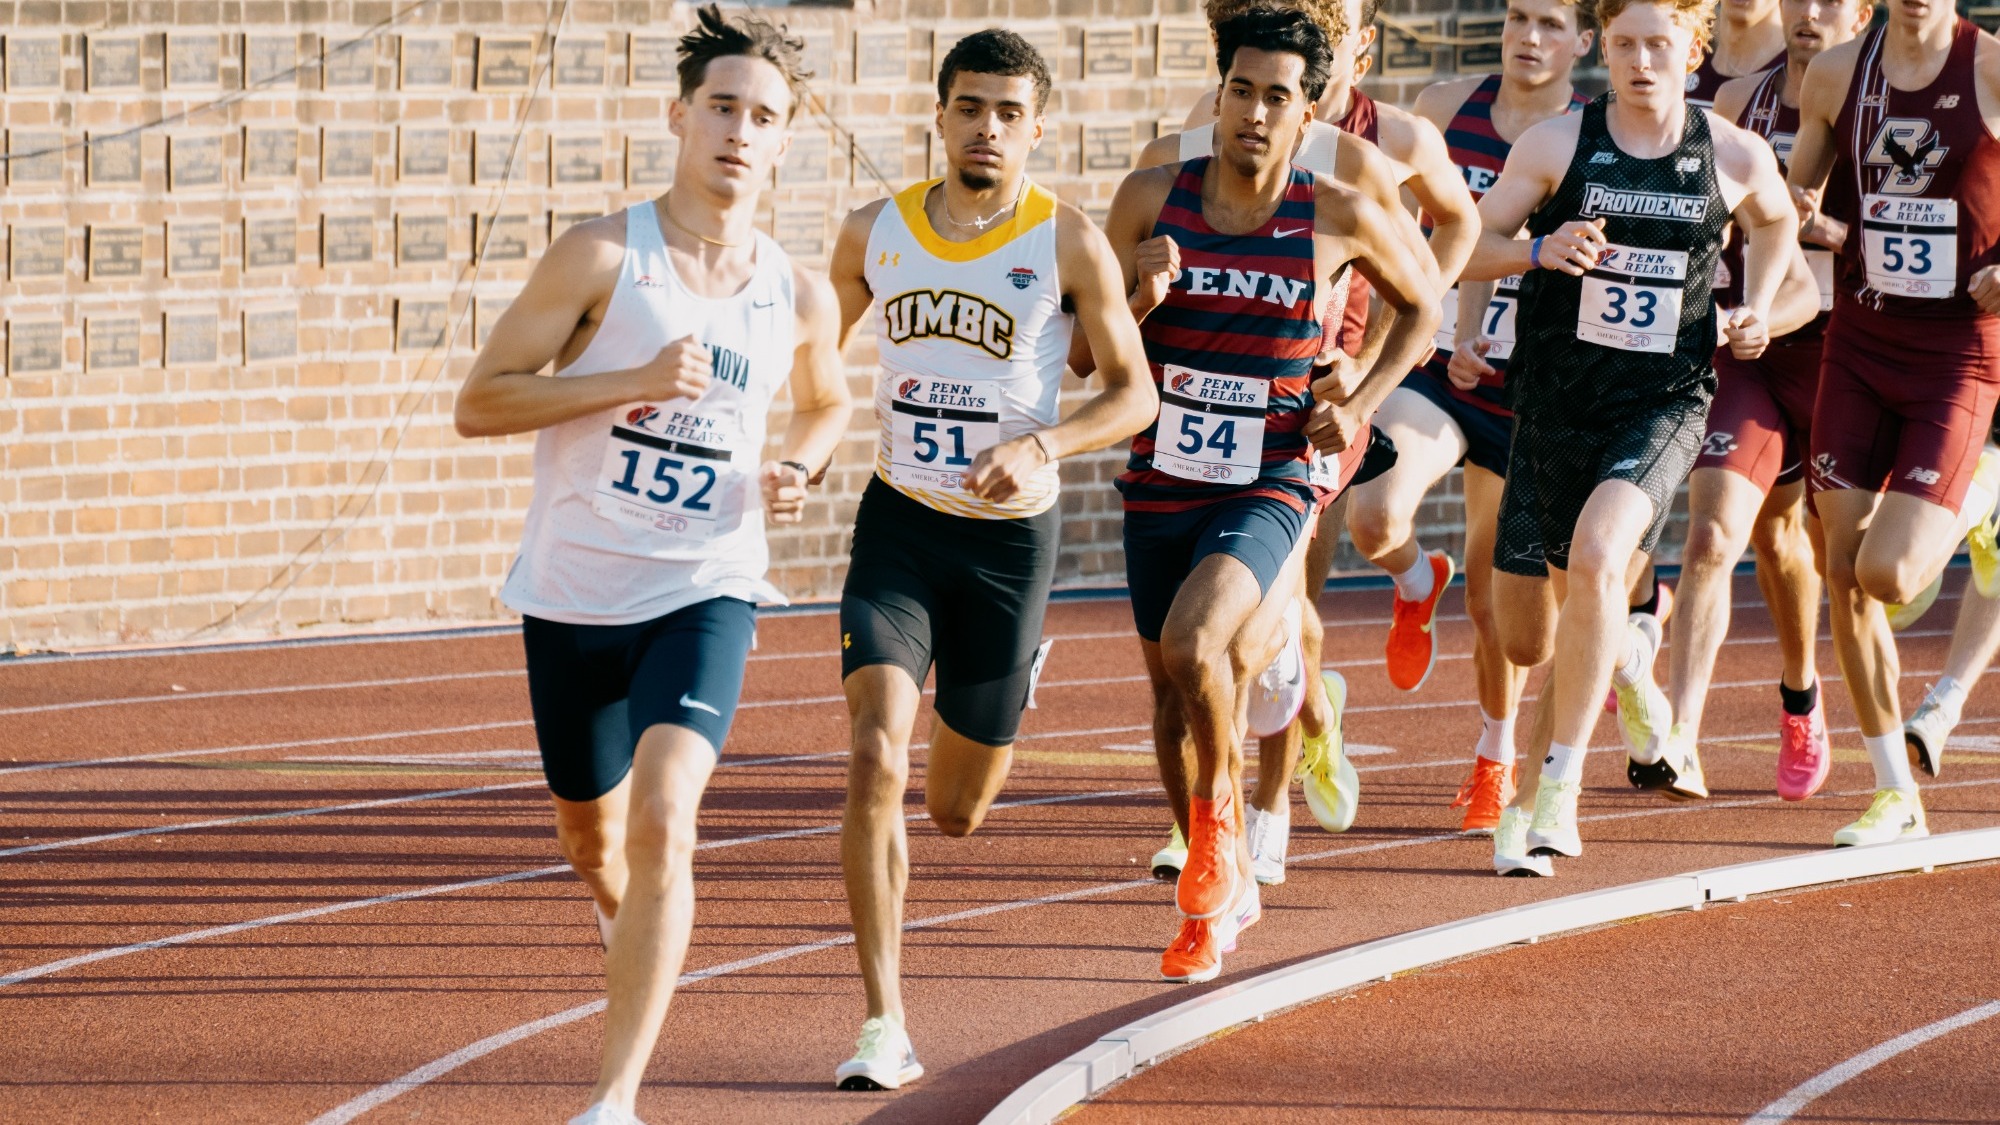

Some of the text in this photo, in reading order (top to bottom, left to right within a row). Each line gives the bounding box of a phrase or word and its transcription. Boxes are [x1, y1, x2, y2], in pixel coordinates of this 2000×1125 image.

[1933, 95, 1960, 109] NB
[1675, 157, 1701, 172] NB
[1898, 202, 1935, 214] PENN
[1896, 212, 1946, 224] RELAYS
[1627, 252, 1666, 264] PENN
[1882, 236, 1932, 275] 53
[1624, 262, 1676, 275] RELAYS
[1006, 272, 1038, 281] AMERICA
[1905, 280, 1931, 294] 250
[1600, 286, 1657, 328] 33
[886, 288, 1016, 361] UMBC
[1624, 333, 1651, 348] 250
[930, 382, 973, 395] PENN
[1201, 377, 1244, 391] PENN
[928, 393, 986, 408] RELAYS
[1199, 388, 1256, 403] RELAYS
[671, 412, 716, 428] PENN
[665, 424, 726, 442] RELAYS
[1176, 413, 1238, 459] 54
[913, 421, 972, 466] 51
[911, 473, 940, 484] AMERICA
[1172, 462, 1232, 480] AMERICA 250
[1904, 466, 1941, 485] NB
[611, 450, 716, 512] 152
[655, 513, 688, 534] 250
